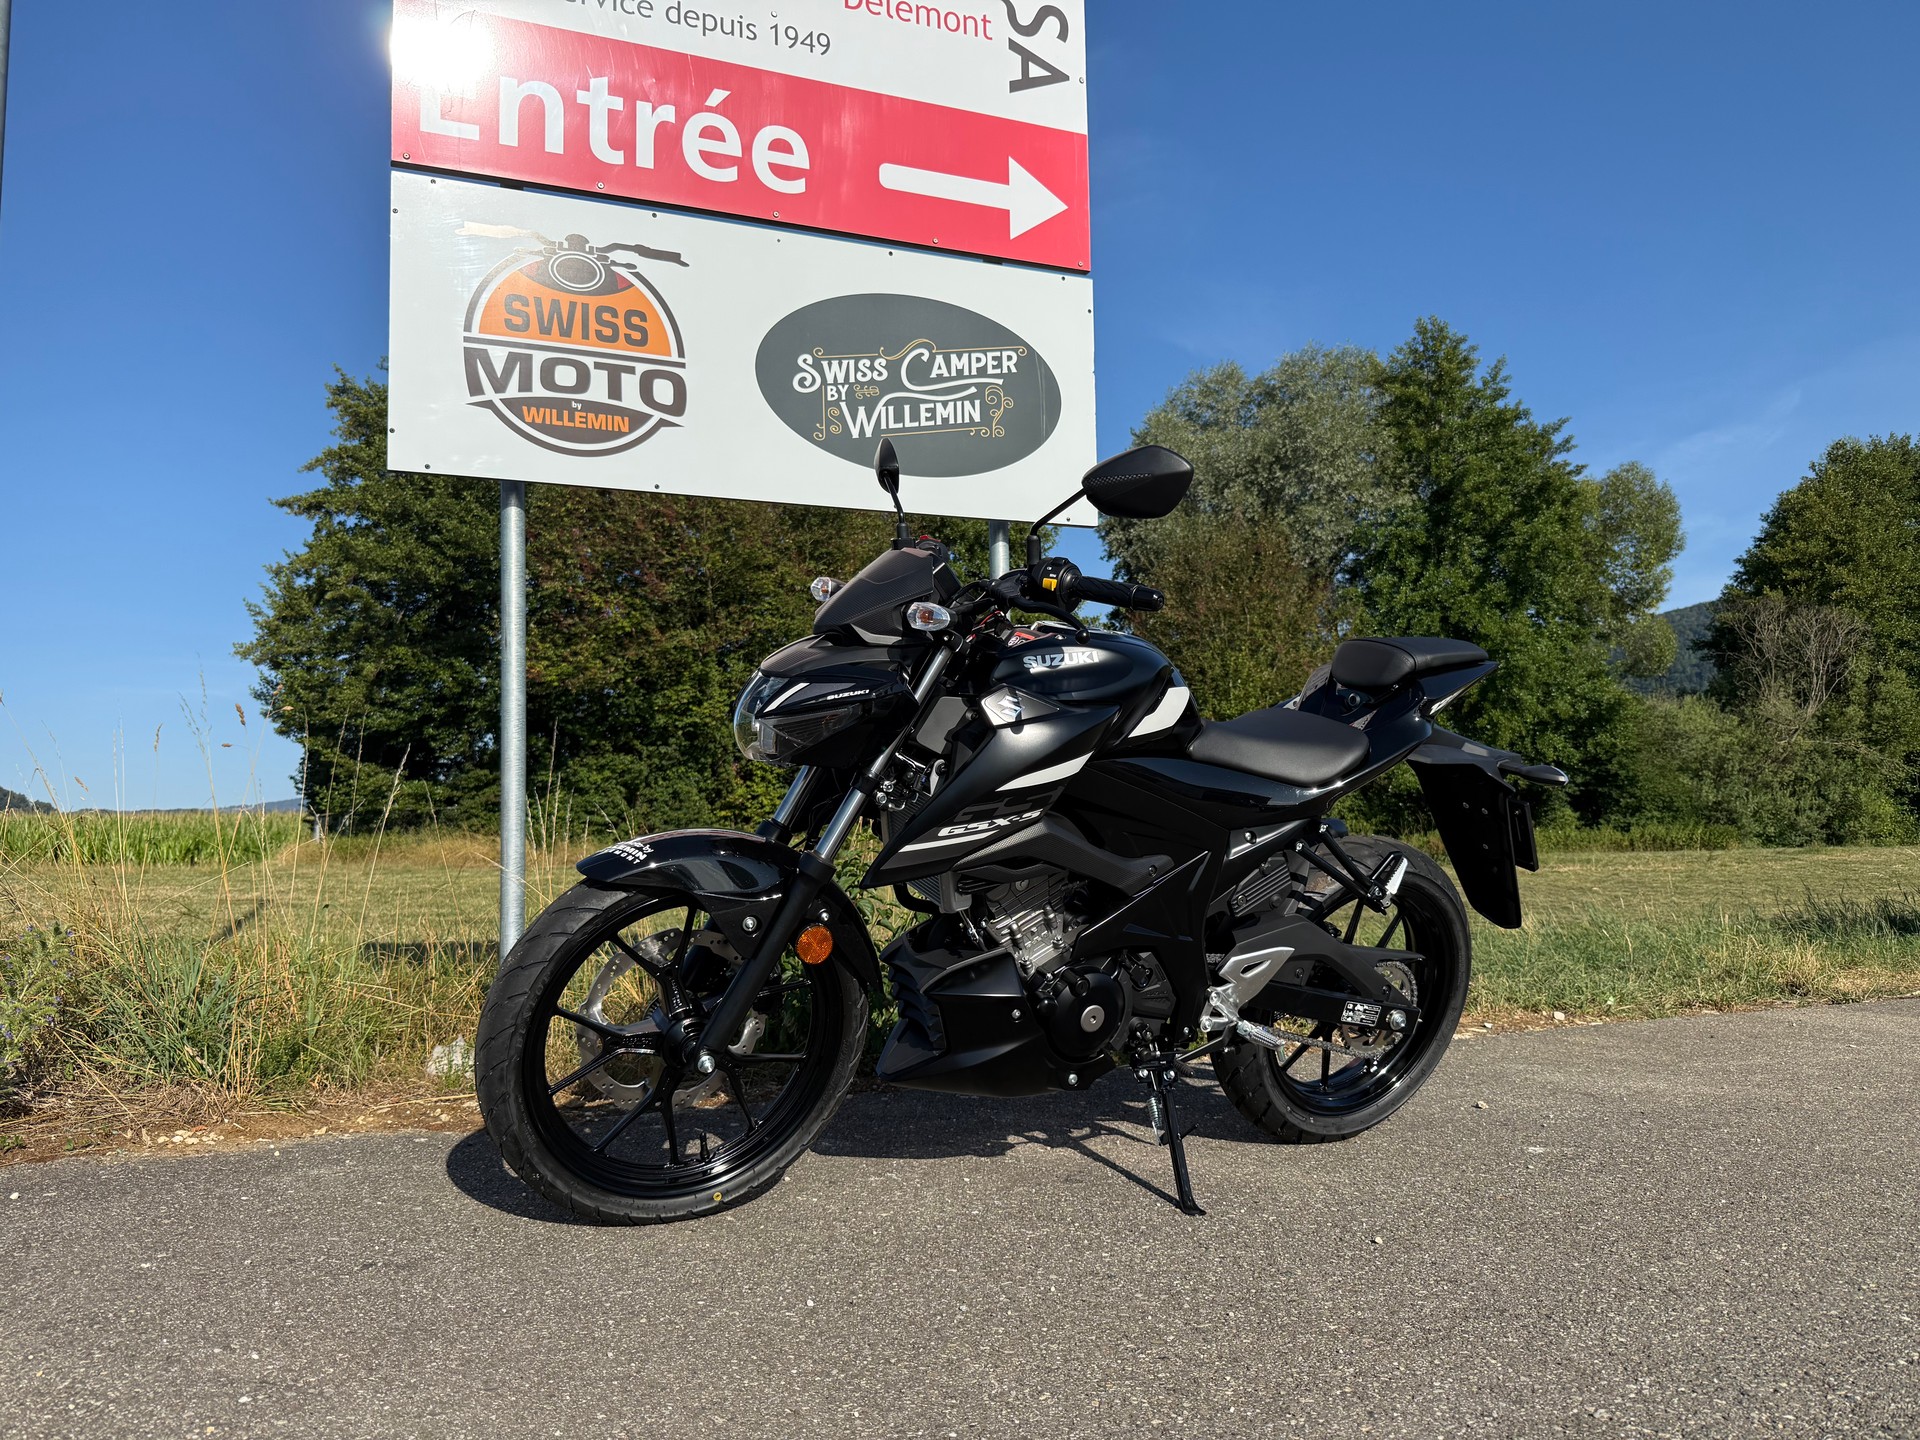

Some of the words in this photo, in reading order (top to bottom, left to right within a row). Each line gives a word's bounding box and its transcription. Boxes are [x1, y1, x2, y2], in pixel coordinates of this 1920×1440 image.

[665, 0, 758, 41] depuis
[770, 23, 831, 56] 1949
[503, 293, 649, 348] SWISS
[463, 346, 688, 418] MOTO
[522, 405, 630, 433] WILLEMIN
[571, 401, 582, 411] by
[1023, 650, 1100, 669] SUZUKI
[826, 689, 870, 700] SUZUKI
[938, 808, 1044, 837] GSX-S
